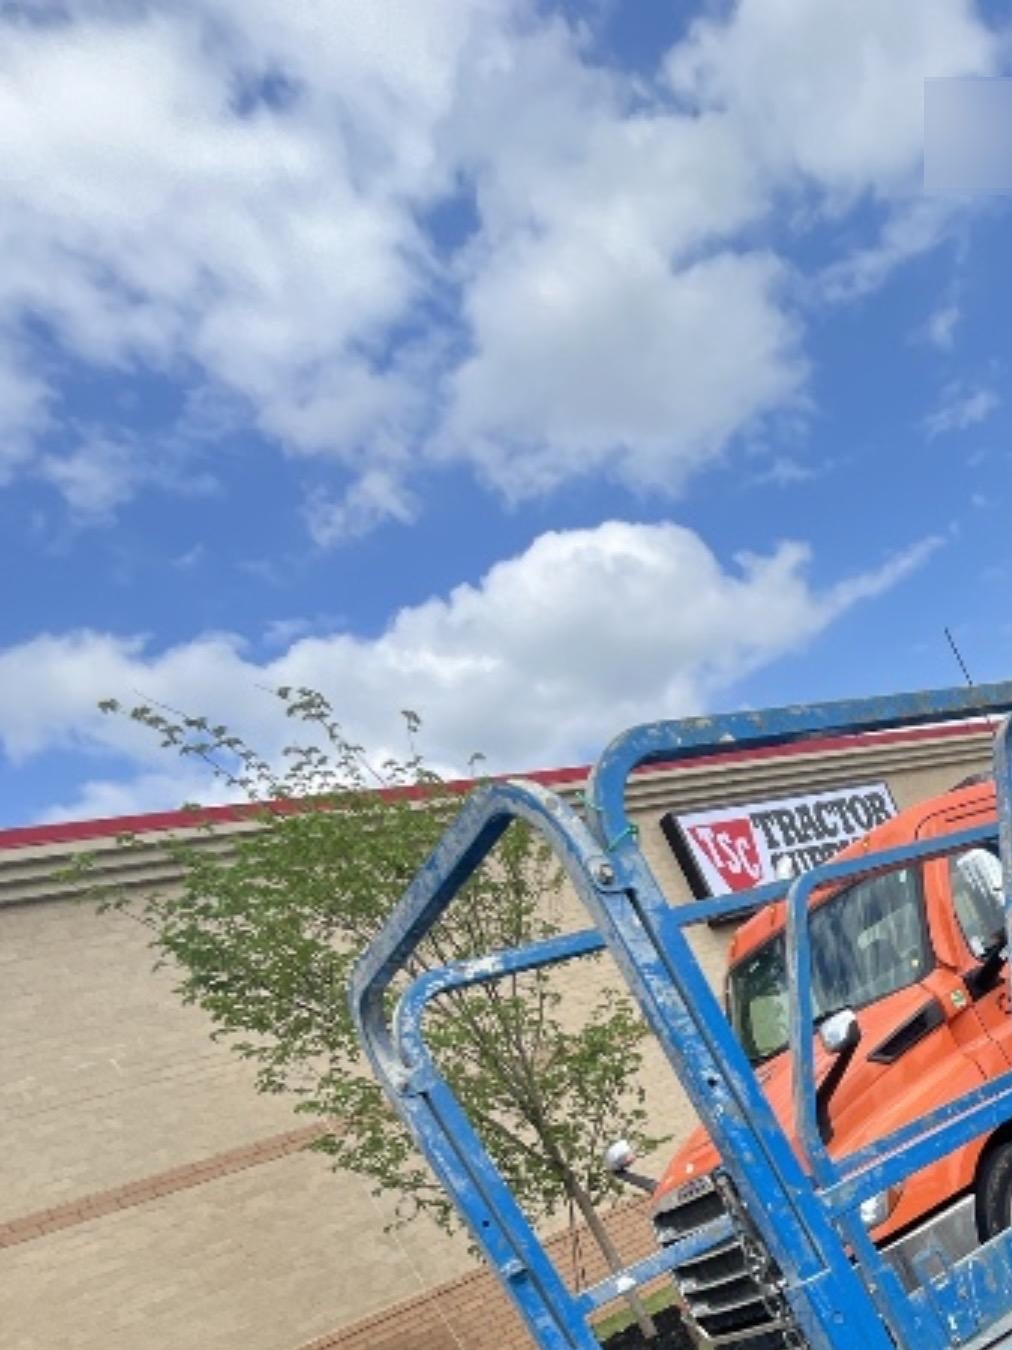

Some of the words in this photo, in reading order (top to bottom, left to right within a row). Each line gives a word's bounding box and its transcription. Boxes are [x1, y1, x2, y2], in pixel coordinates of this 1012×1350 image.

[750, 791, 893, 850] TRACTOR
[694, 825, 761, 881] TSC
[770, 836, 861, 879] UPP
